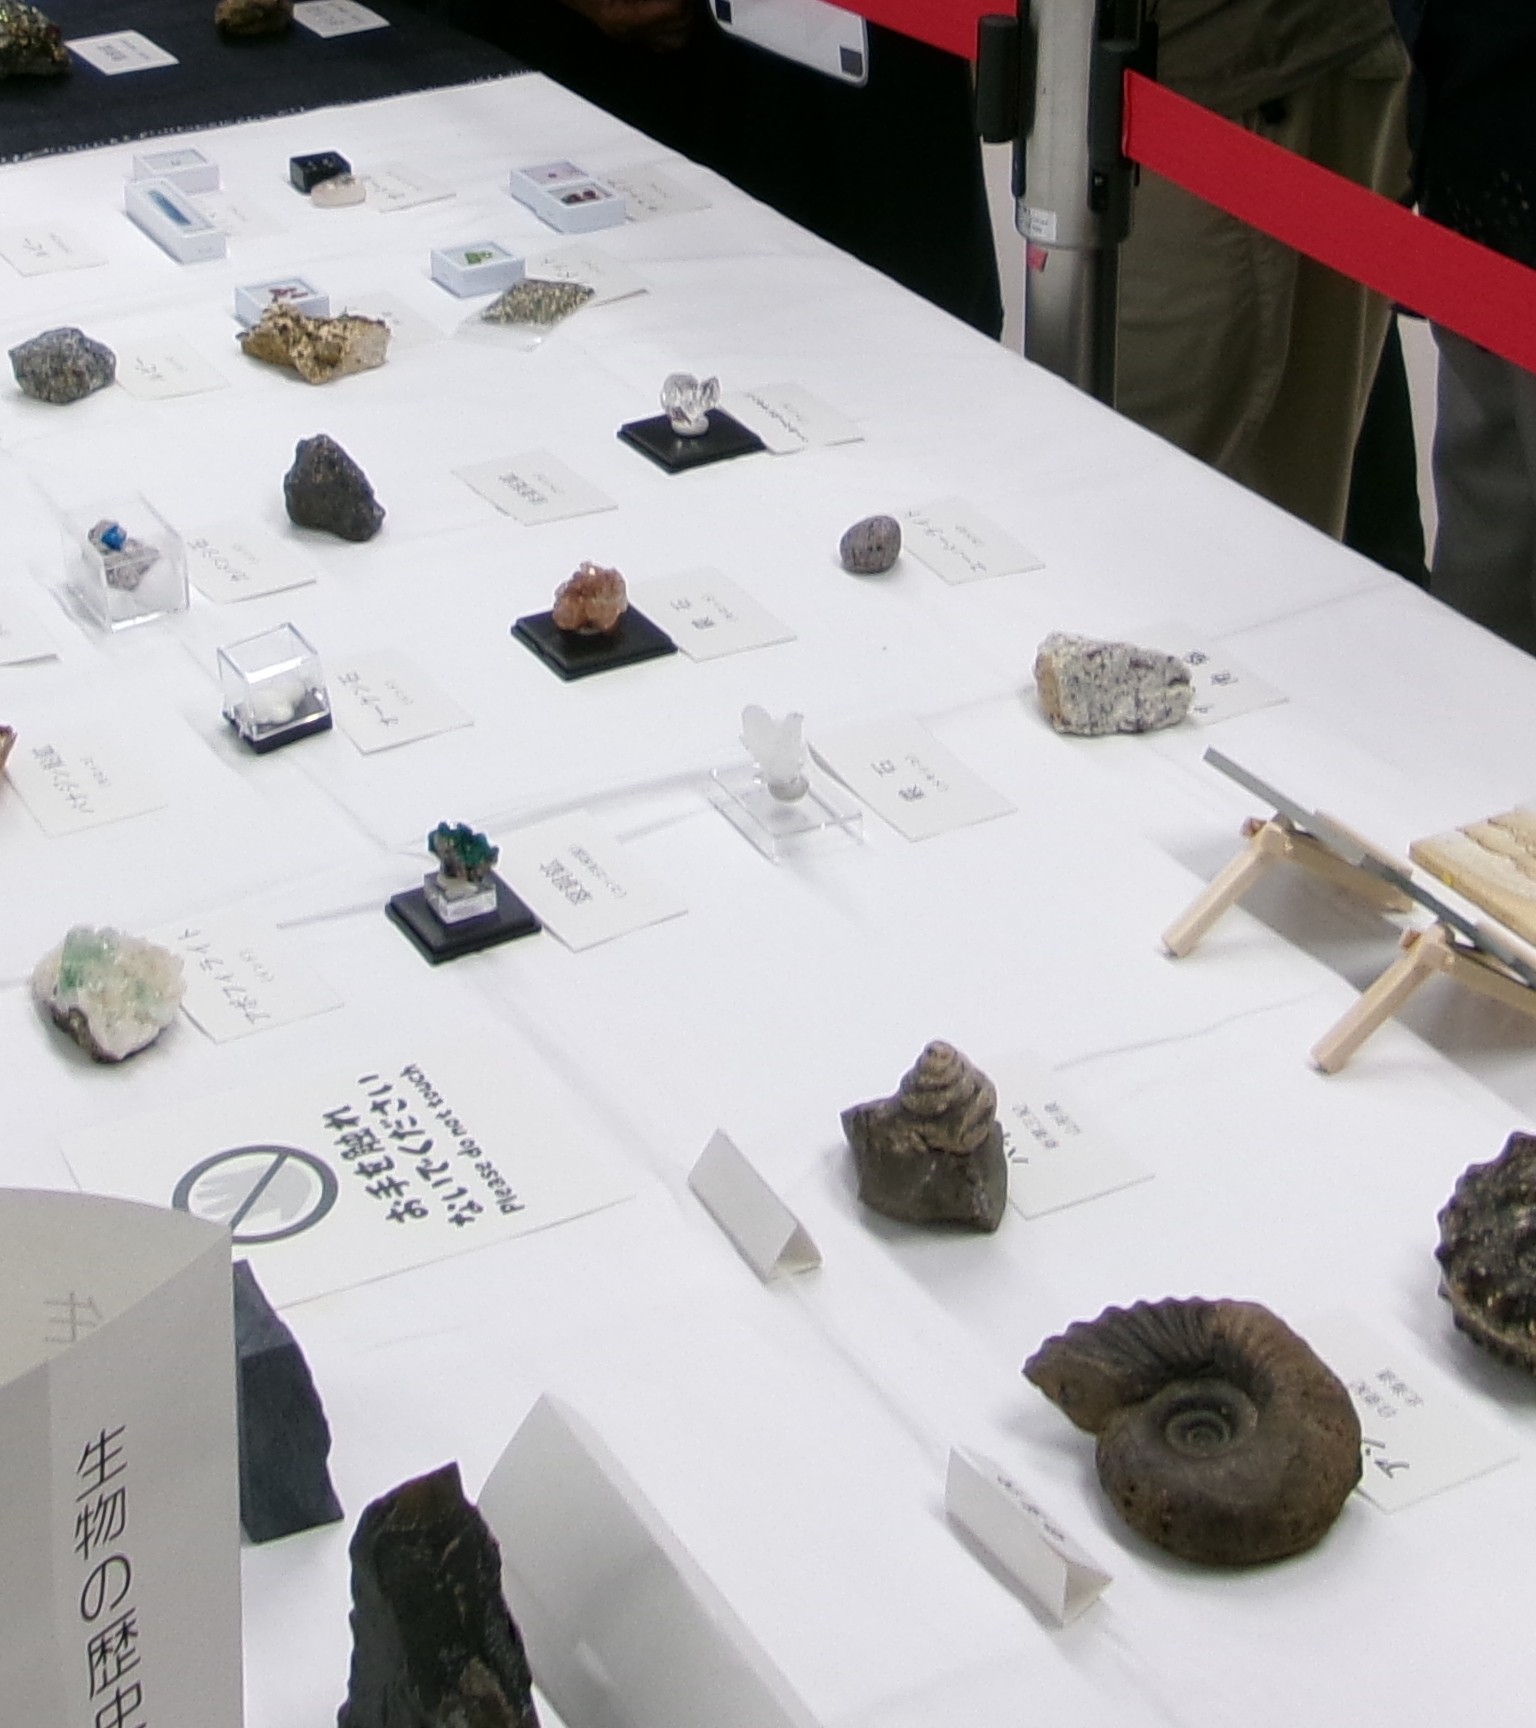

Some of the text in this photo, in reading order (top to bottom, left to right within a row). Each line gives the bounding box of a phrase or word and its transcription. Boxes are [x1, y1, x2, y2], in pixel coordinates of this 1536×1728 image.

[323, 1104, 429, 1224] お手を触れ
[357, 1074, 484, 1227] ないでください
[400, 1063, 525, 1215] Please do not touch
